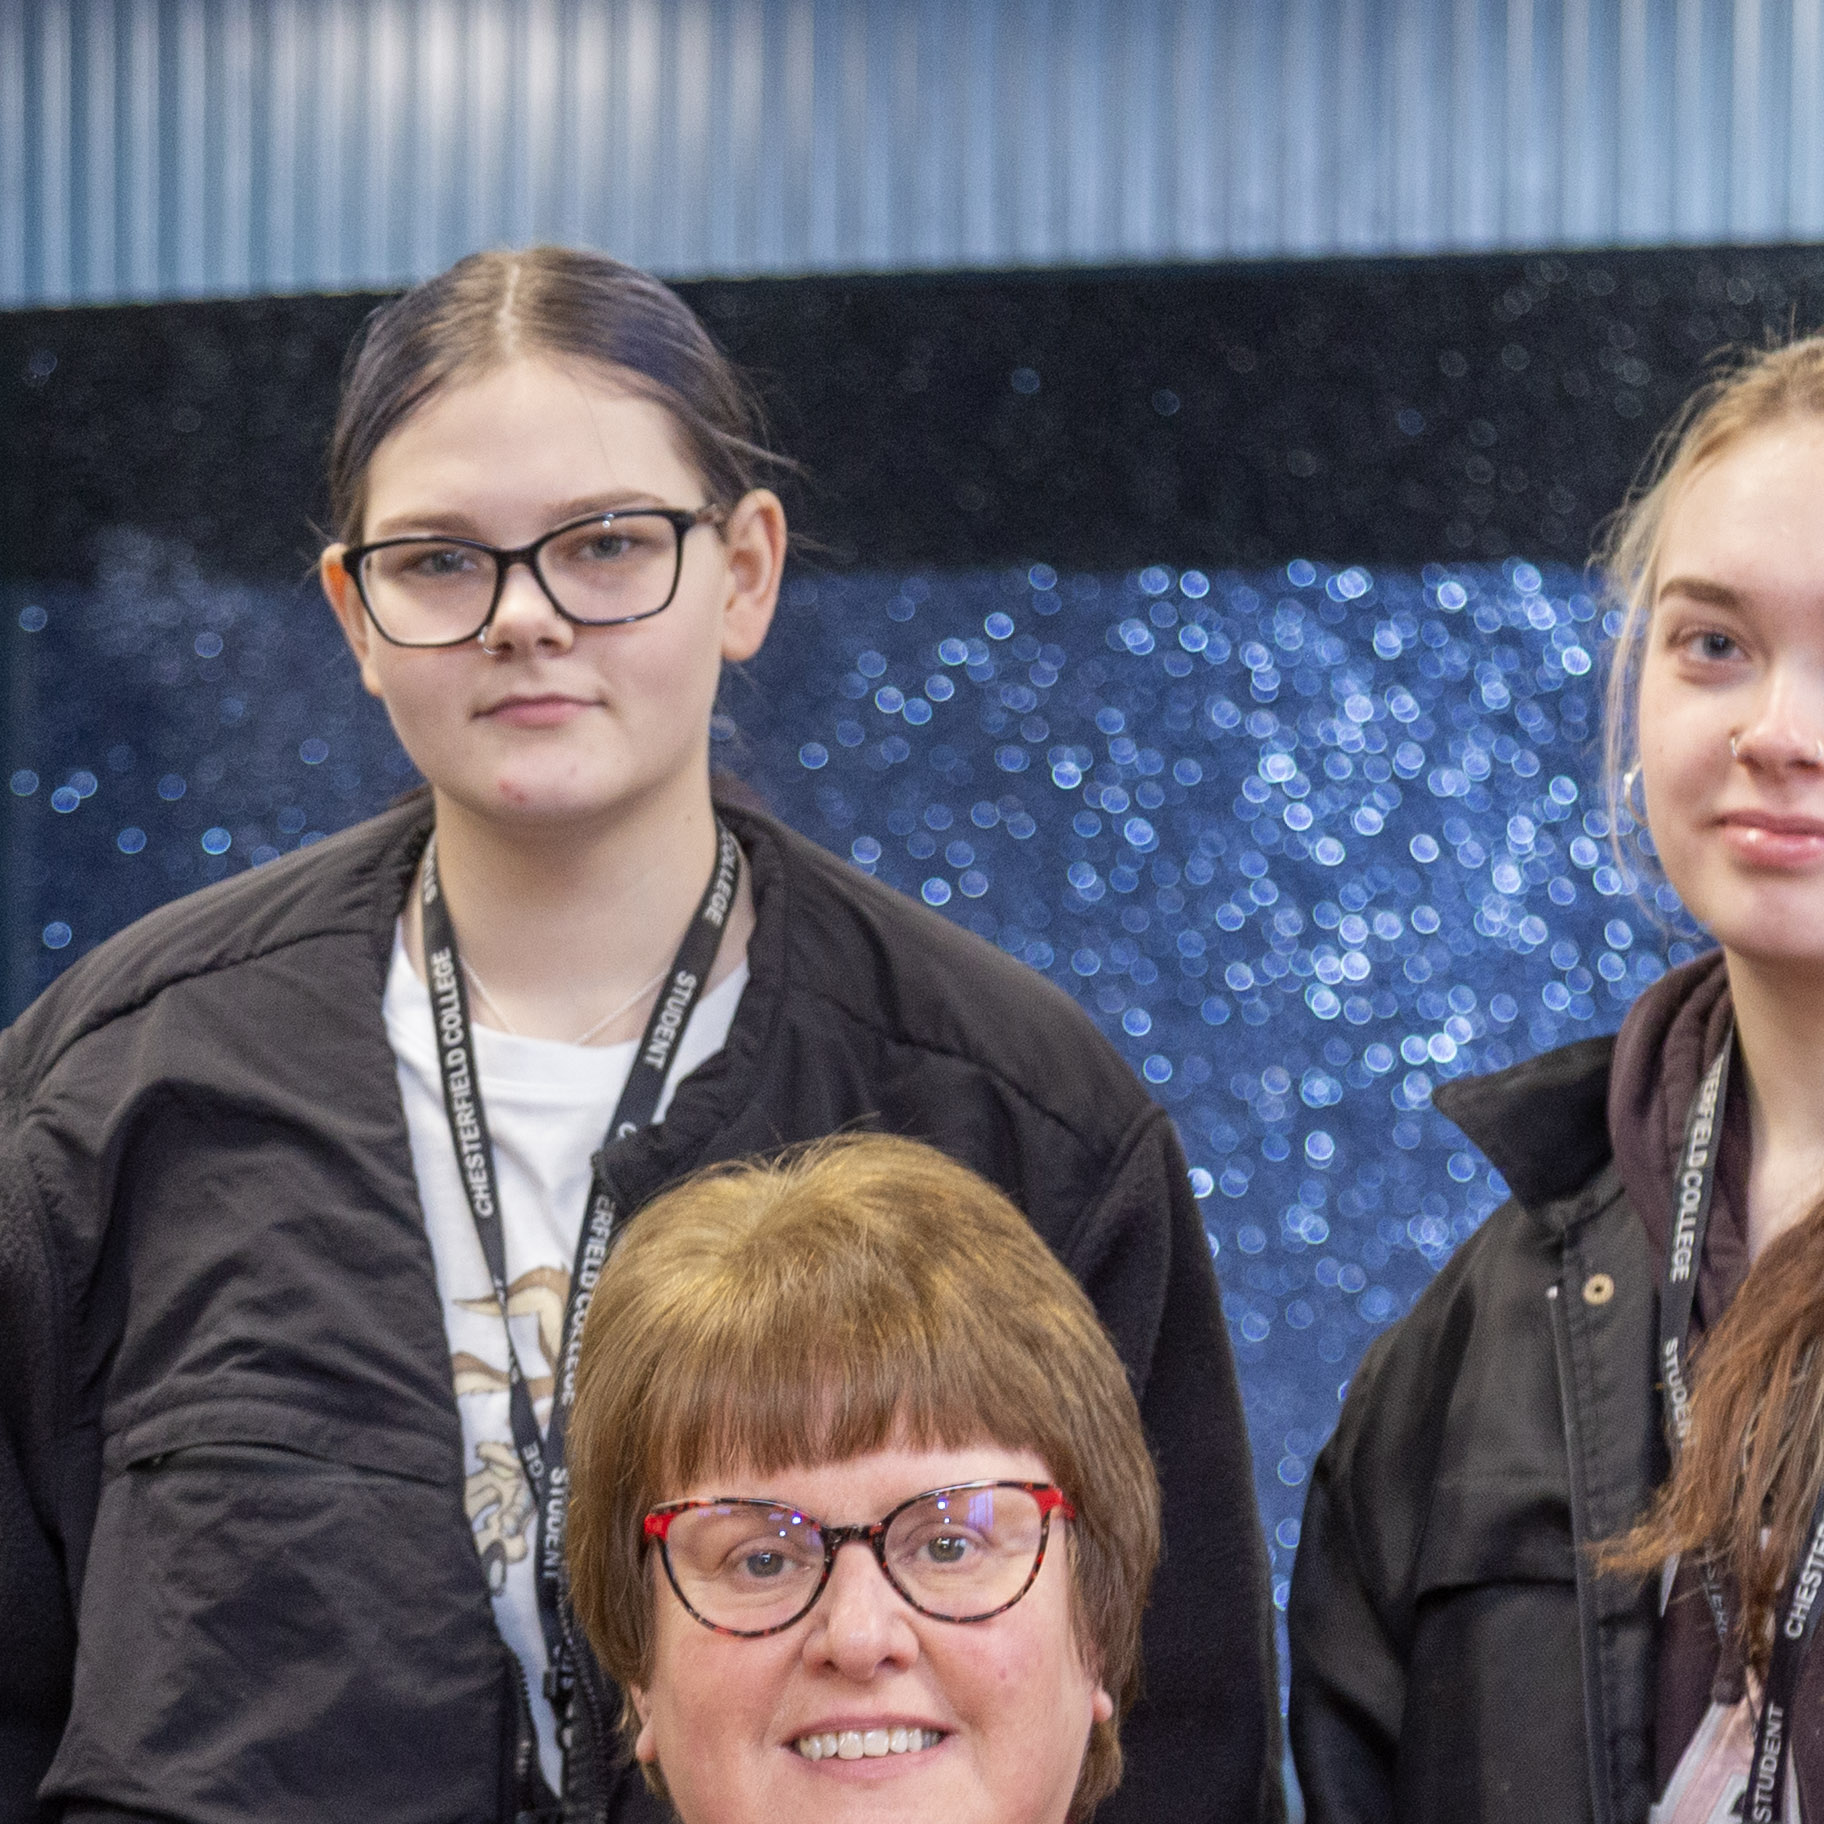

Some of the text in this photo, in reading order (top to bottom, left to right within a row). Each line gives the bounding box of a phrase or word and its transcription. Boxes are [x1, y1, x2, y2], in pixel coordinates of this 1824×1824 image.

[643, 970, 697, 1071] STUDENT
[431, 946, 496, 1218] CHESTERFIELD COLLEGE
[1670, 1169, 1703, 1283] COLLEGE
[1753, 1702, 1784, 1823] STUDENT
